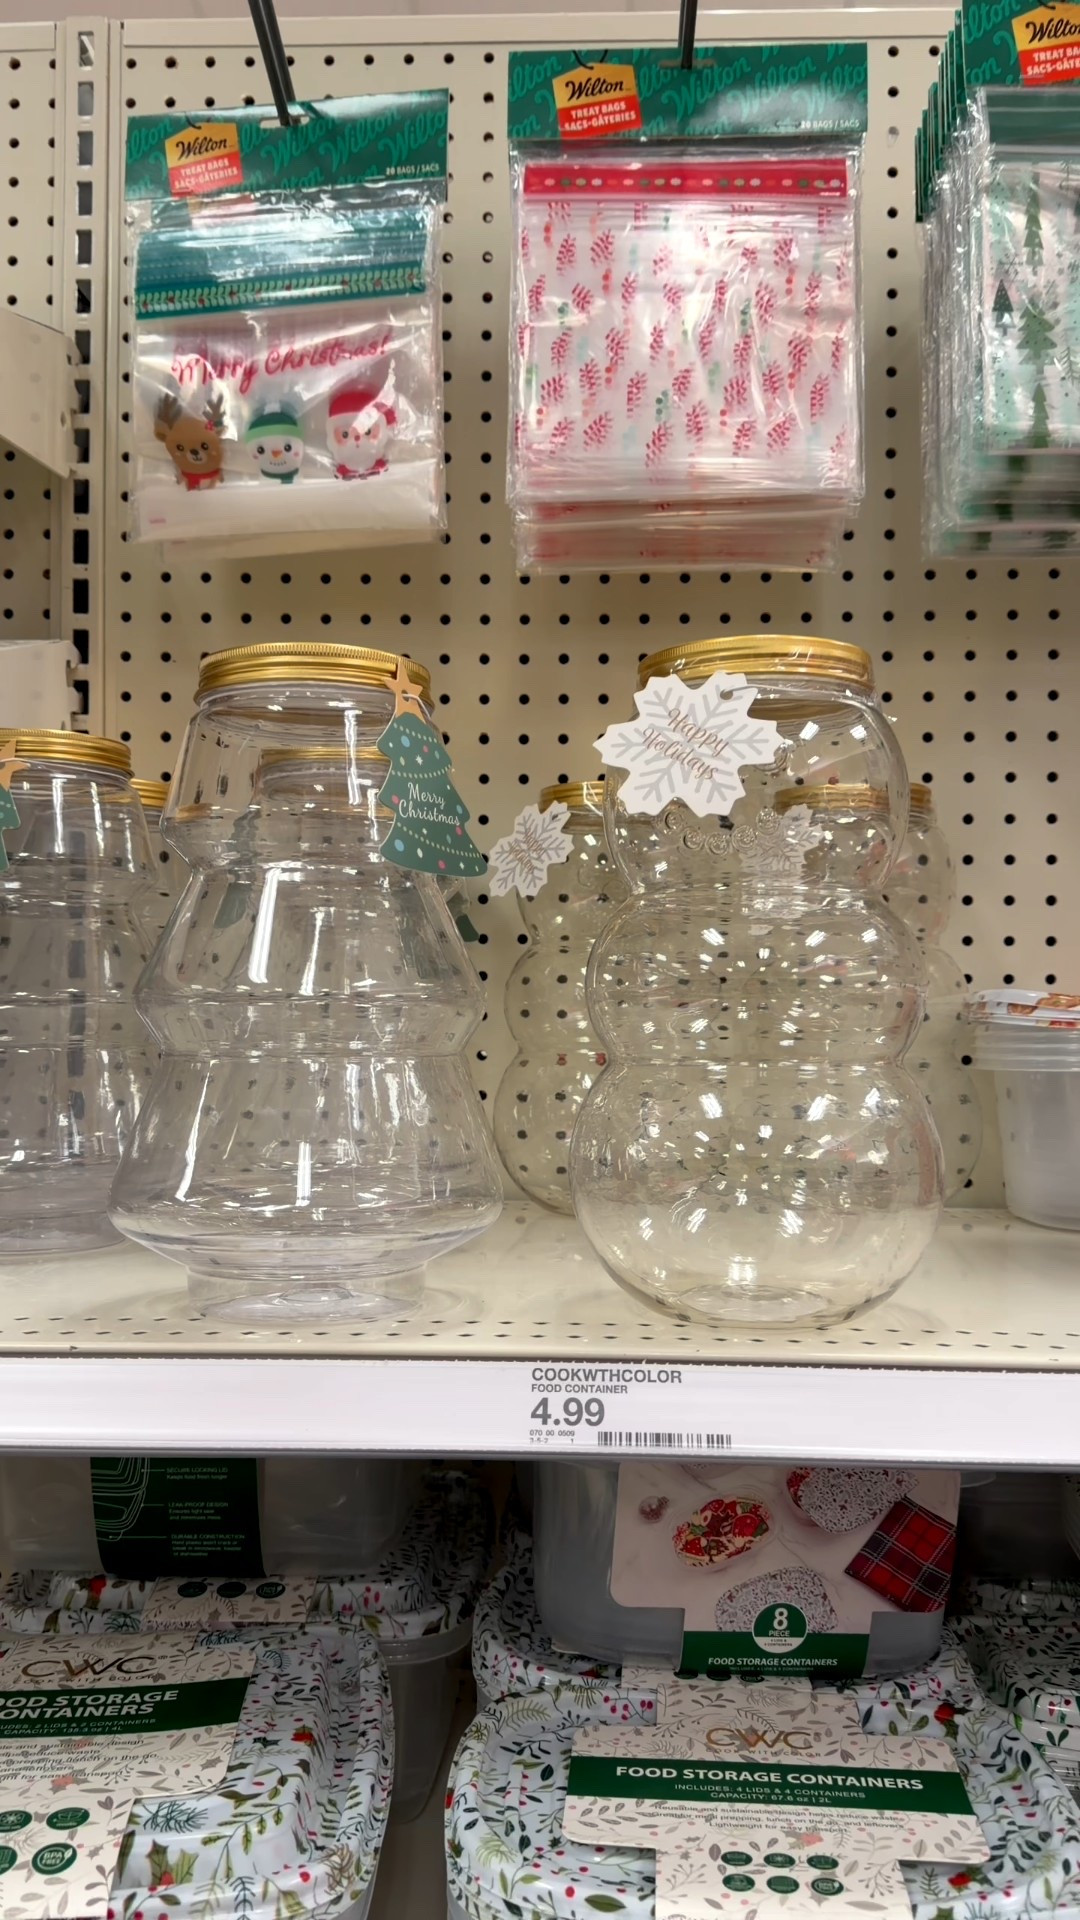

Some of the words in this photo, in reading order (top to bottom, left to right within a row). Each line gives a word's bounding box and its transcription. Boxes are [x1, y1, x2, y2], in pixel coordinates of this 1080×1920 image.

[1025, 18, 1080, 44] Wilto
[1033, 49, 1064, 63] TREAT
[1066, 46, 1080, 57] BA
[1026, 57, 1080, 76] SACS-GÂTE
[565, 77, 624, 102] Wilton
[726, 56, 816, 122] Wilton
[791, 58, 867, 120] Wilto
[571, 105, 600, 120] TREAT
[601, 101, 626, 114] BAGS
[564, 111, 637, 131] SACS-GÂTERIES
[800, 120, 811, 129] 20
[813, 120, 833, 128] BAGS
[840, 119, 860, 128] SACS
[319, 107, 399, 173] Wilton
[377, 108, 447, 166] Wilto
[175, 135, 228, 161] Wilton
[181, 165, 207, 177] TREAT
[208, 158, 230, 171] BAGS
[386, 167, 396, 176] 20
[397, 165, 416, 175] BAGS
[421, 163, 440, 173] SACS
[174, 167, 239, 190] SACS-GÂTERIES
[668, 707, 730, 757] Happy
[642, 728, 719, 780] Holidays
[407, 781, 446, 810] Merry
[398, 799, 460, 826] Christmas
[531, 1367, 683, 1383] COOKWTHCOLOR
[531, 1383, 562, 1393] FOOD
[564, 1384, 628, 1394] CONTAINER
[530, 1397, 605, 1427] 4.99
[529, 1429, 543, 1437] 070
[773, 1607, 789, 1630] 8
[768, 1630, 790, 1638] PIECE
[21, 1656, 158, 1677] CWC
[708, 1657, 735, 1666] FOOD
[737, 1658, 779, 1666] STORAGE
[780, 1658, 838, 1667] CONTAINERS
[0, 1696, 48, 1708] OD
[53, 1690, 179, 1707] STORAGE
[0, 1703, 155, 1720] ONTAINERS
[90, 1718, 156, 1727] CONTAINERS
[706, 1727, 814, 1750] CWC
[615, 1766, 678, 1779] FOOD
[683, 1768, 782, 1784] STORAGE
[786, 1773, 924, 1791] CONTAINERS
[674, 1784, 733, 1792] INCLUDES:
[794, 1789, 866, 1798] CONTAINERS
[710, 1792, 768, 1800] CAPACITY:
[43, 1850, 64, 1859] BPA
